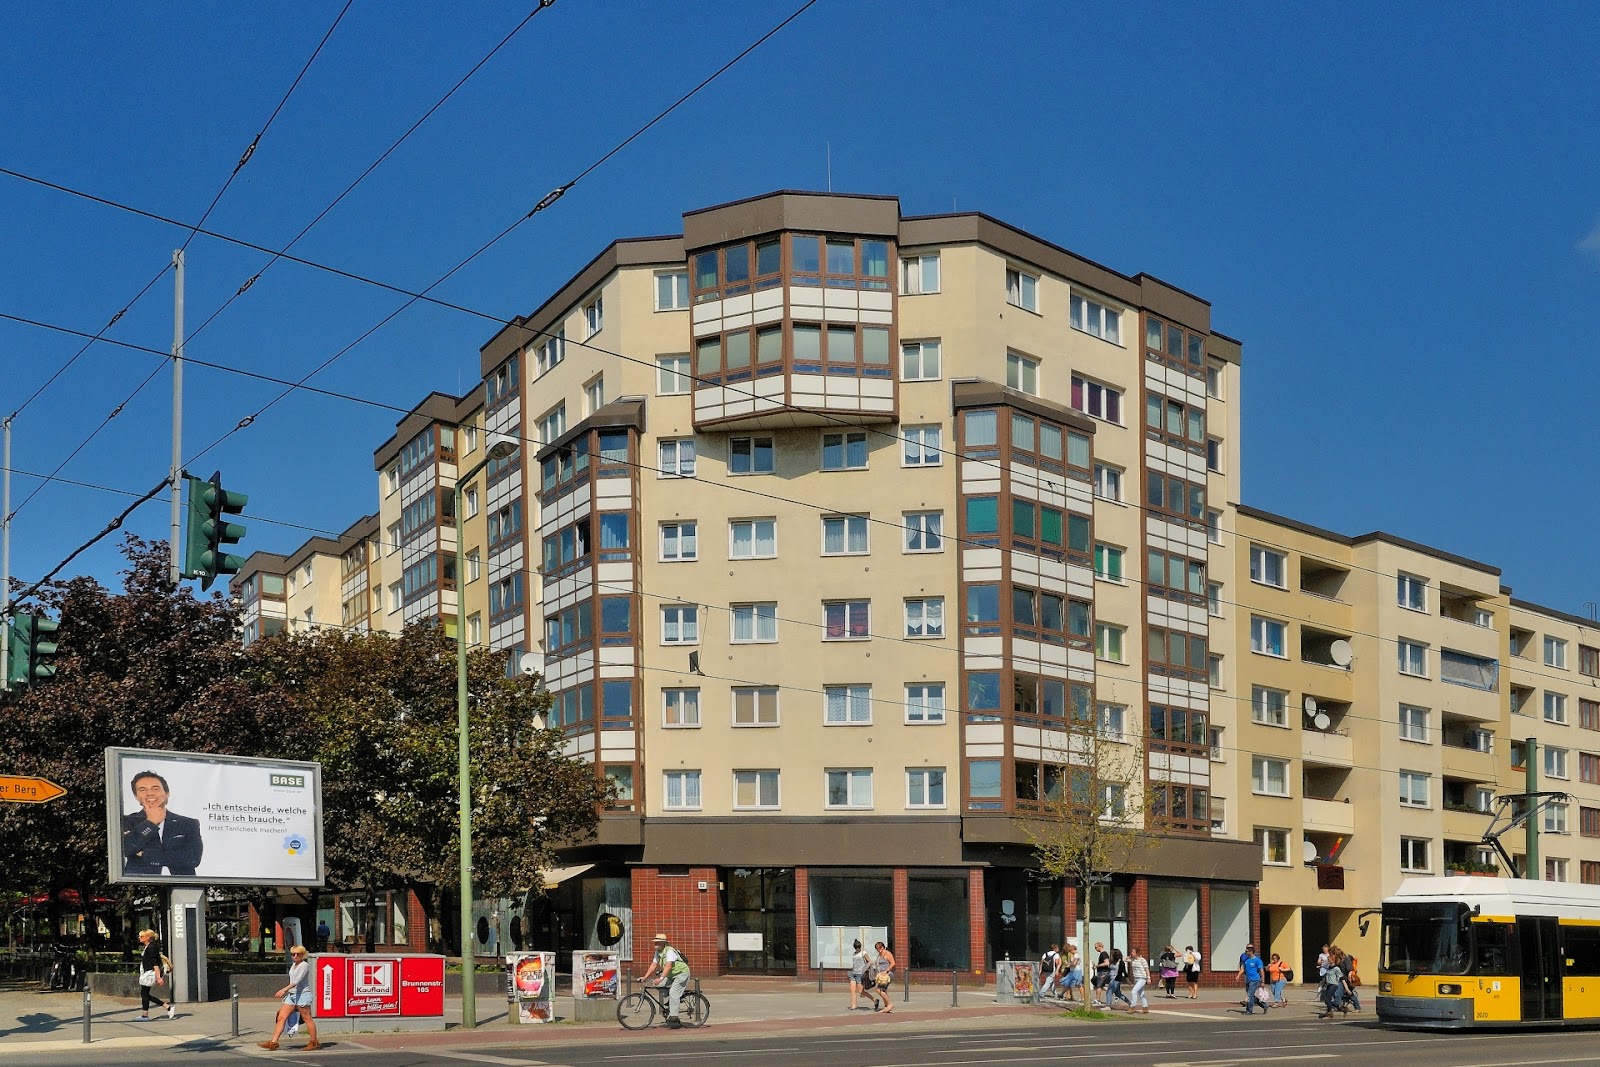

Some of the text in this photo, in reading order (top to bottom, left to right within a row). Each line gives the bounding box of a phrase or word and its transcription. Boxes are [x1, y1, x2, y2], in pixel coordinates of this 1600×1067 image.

[272, 776, 303, 786] BASE
[14, 784, 37, 797] Berg
[224, 804, 275, 814] entscheide,
[277, 806, 307, 815] welche
[208, 813, 230, 821] Flats
[232, 814, 246, 822] ich
[225, 825, 258, 833] Tarifcheck
[174, 903, 184, 939] STRÖER
